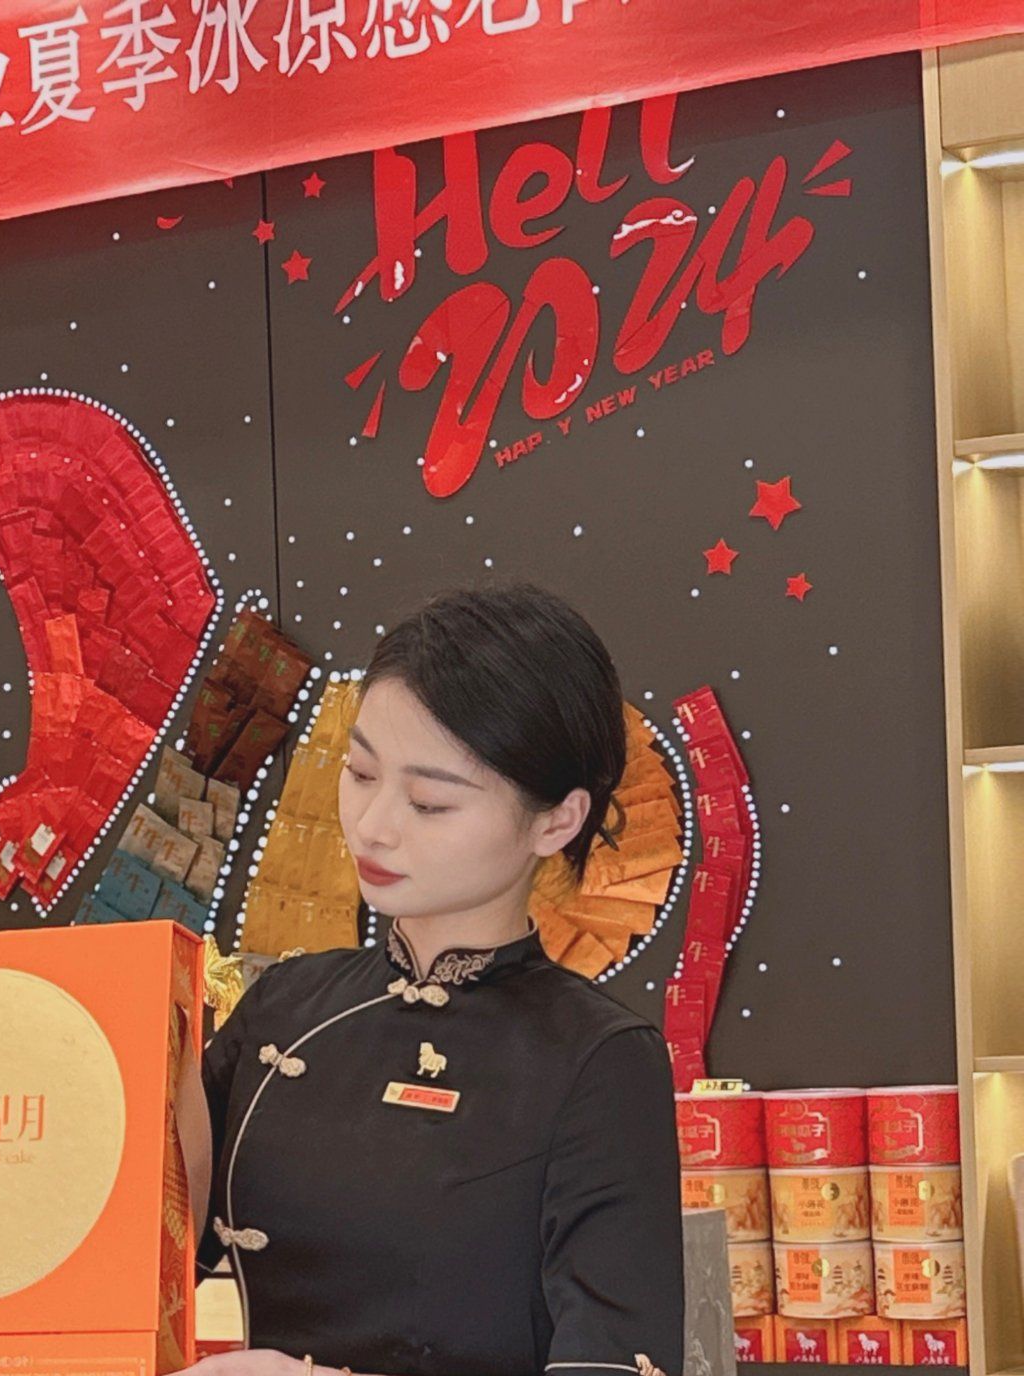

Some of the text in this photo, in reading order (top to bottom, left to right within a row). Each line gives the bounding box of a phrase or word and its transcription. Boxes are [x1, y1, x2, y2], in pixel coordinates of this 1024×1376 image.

[398, 156, 814, 498] 2024
[585, 385, 638, 423] NEW
[648, 349, 715, 391] YEAR
